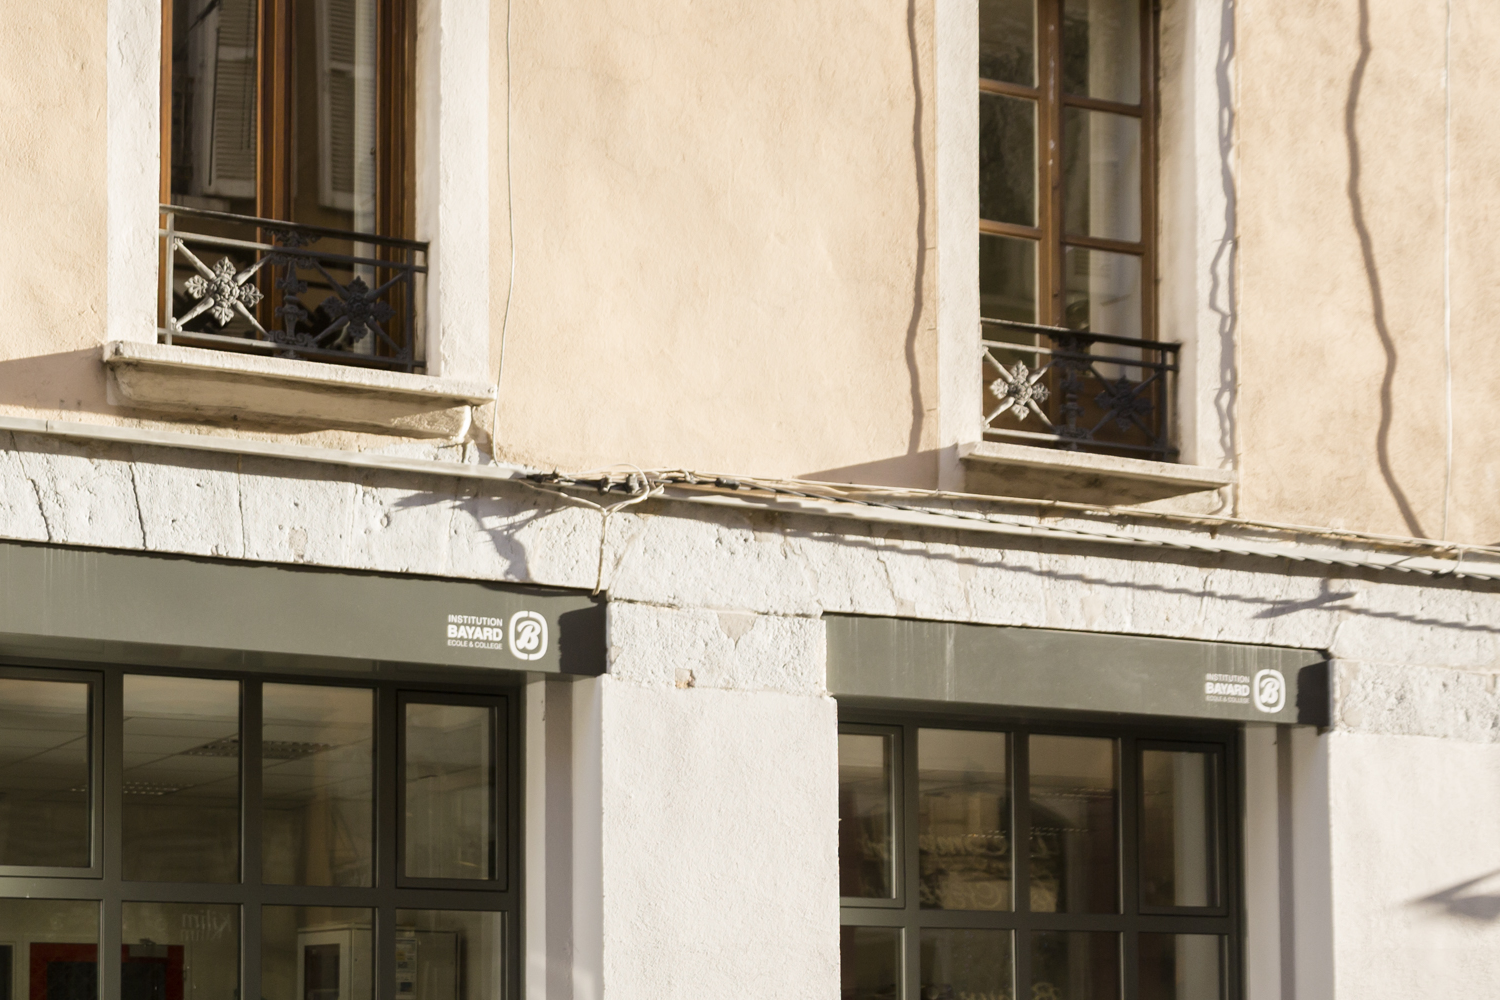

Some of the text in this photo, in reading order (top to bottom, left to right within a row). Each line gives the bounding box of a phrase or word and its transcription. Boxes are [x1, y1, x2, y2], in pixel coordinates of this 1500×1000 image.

[448, 615, 502, 626] INSTITUTION
[448, 625, 502, 641] BAYARD
[1205, 673, 1250, 684] INSTITUTION
[1205, 682, 1250, 696] BAYARD
